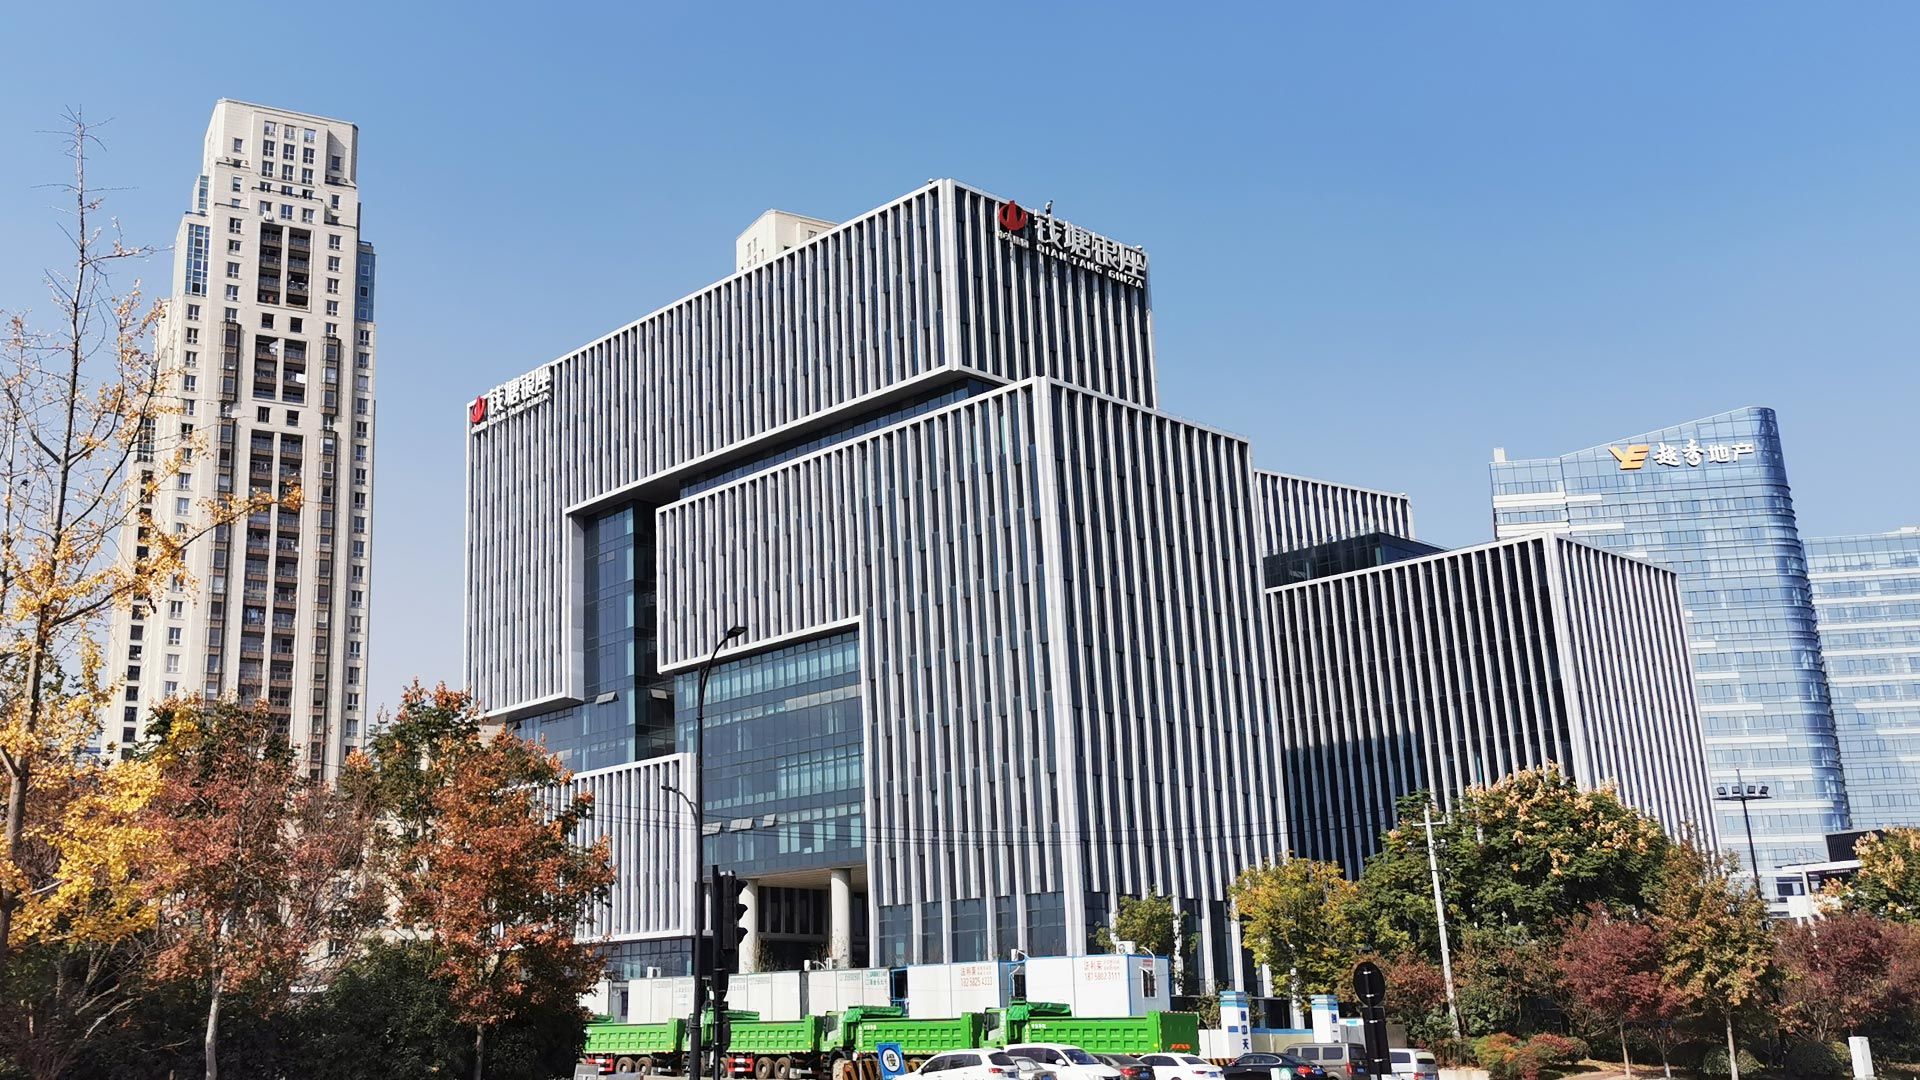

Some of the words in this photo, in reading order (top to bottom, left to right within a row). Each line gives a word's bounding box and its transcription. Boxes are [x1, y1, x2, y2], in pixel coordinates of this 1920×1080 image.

[1034, 209, 1147, 280] 钱塘银座
[1036, 244, 1067, 262] QIAN
[1071, 255, 1103, 275] TANG
[1108, 270, 1144, 289] GINZA
[526, 393, 549, 408] GINZA
[1653, 439, 1754, 467] 越秀地产
